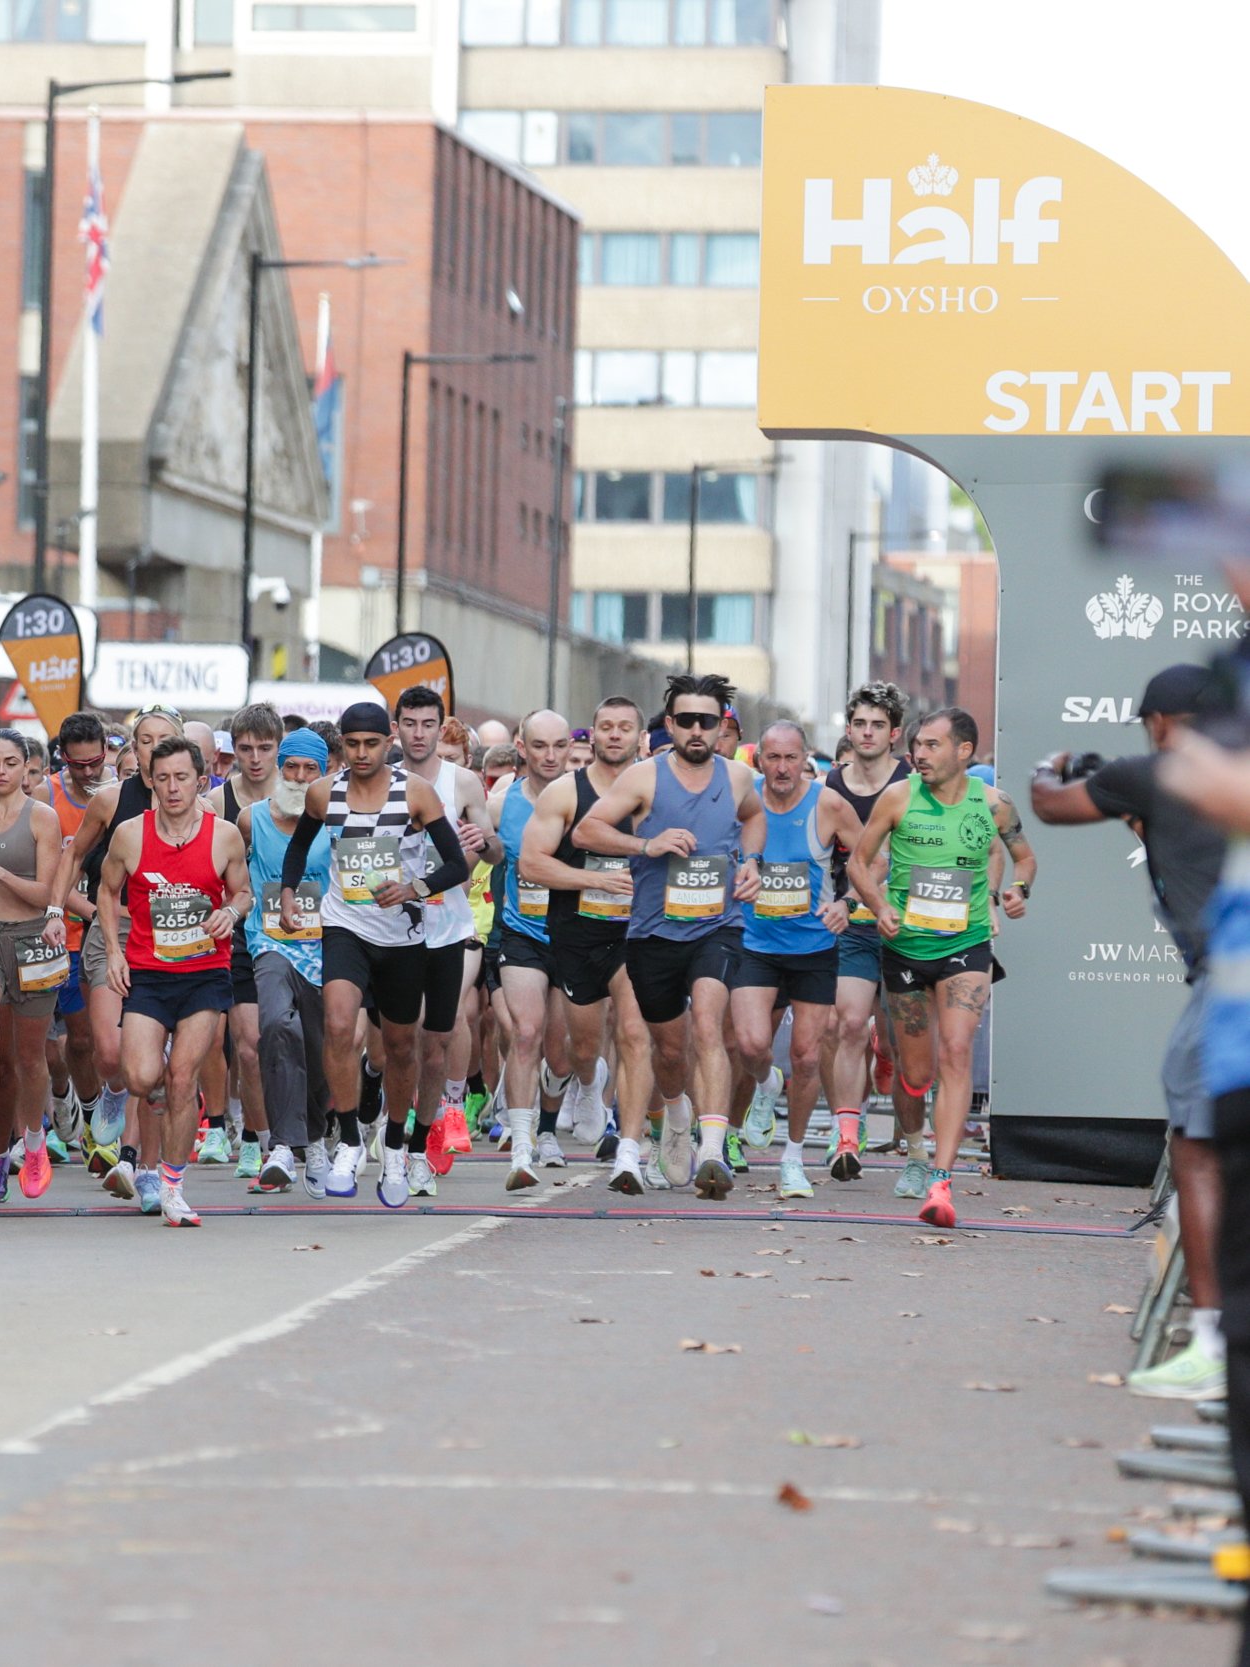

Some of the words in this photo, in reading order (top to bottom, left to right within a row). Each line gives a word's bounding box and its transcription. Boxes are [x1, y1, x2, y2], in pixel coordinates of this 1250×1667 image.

[803, 176, 1062, 264] Half
[862, 286, 999, 313] OYSHO
[983, 370, 1230, 432] START
[1174, 574, 1203, 586] THE
[15, 609, 65, 637] 1:30
[381, 641, 431, 673] 1:30
[29, 657, 78, 683] Half
[116, 659, 219, 692] TENZING
[907, 835, 943, 846] RELAB
[342, 852, 396, 869] 16065
[677, 872, 719, 886] 8595
[677, 891, 711, 902] ANGUS
[916, 882, 964, 900] 17572
[268, 897, 315, 910] 1438
[155, 910, 207, 928] 26567
[161, 929, 198, 943] JOSH
[1083, 944, 1123, 961] JW
[1128, 944, 1184, 962] MAR
[1068, 972, 1150, 983] GROSVENOR
